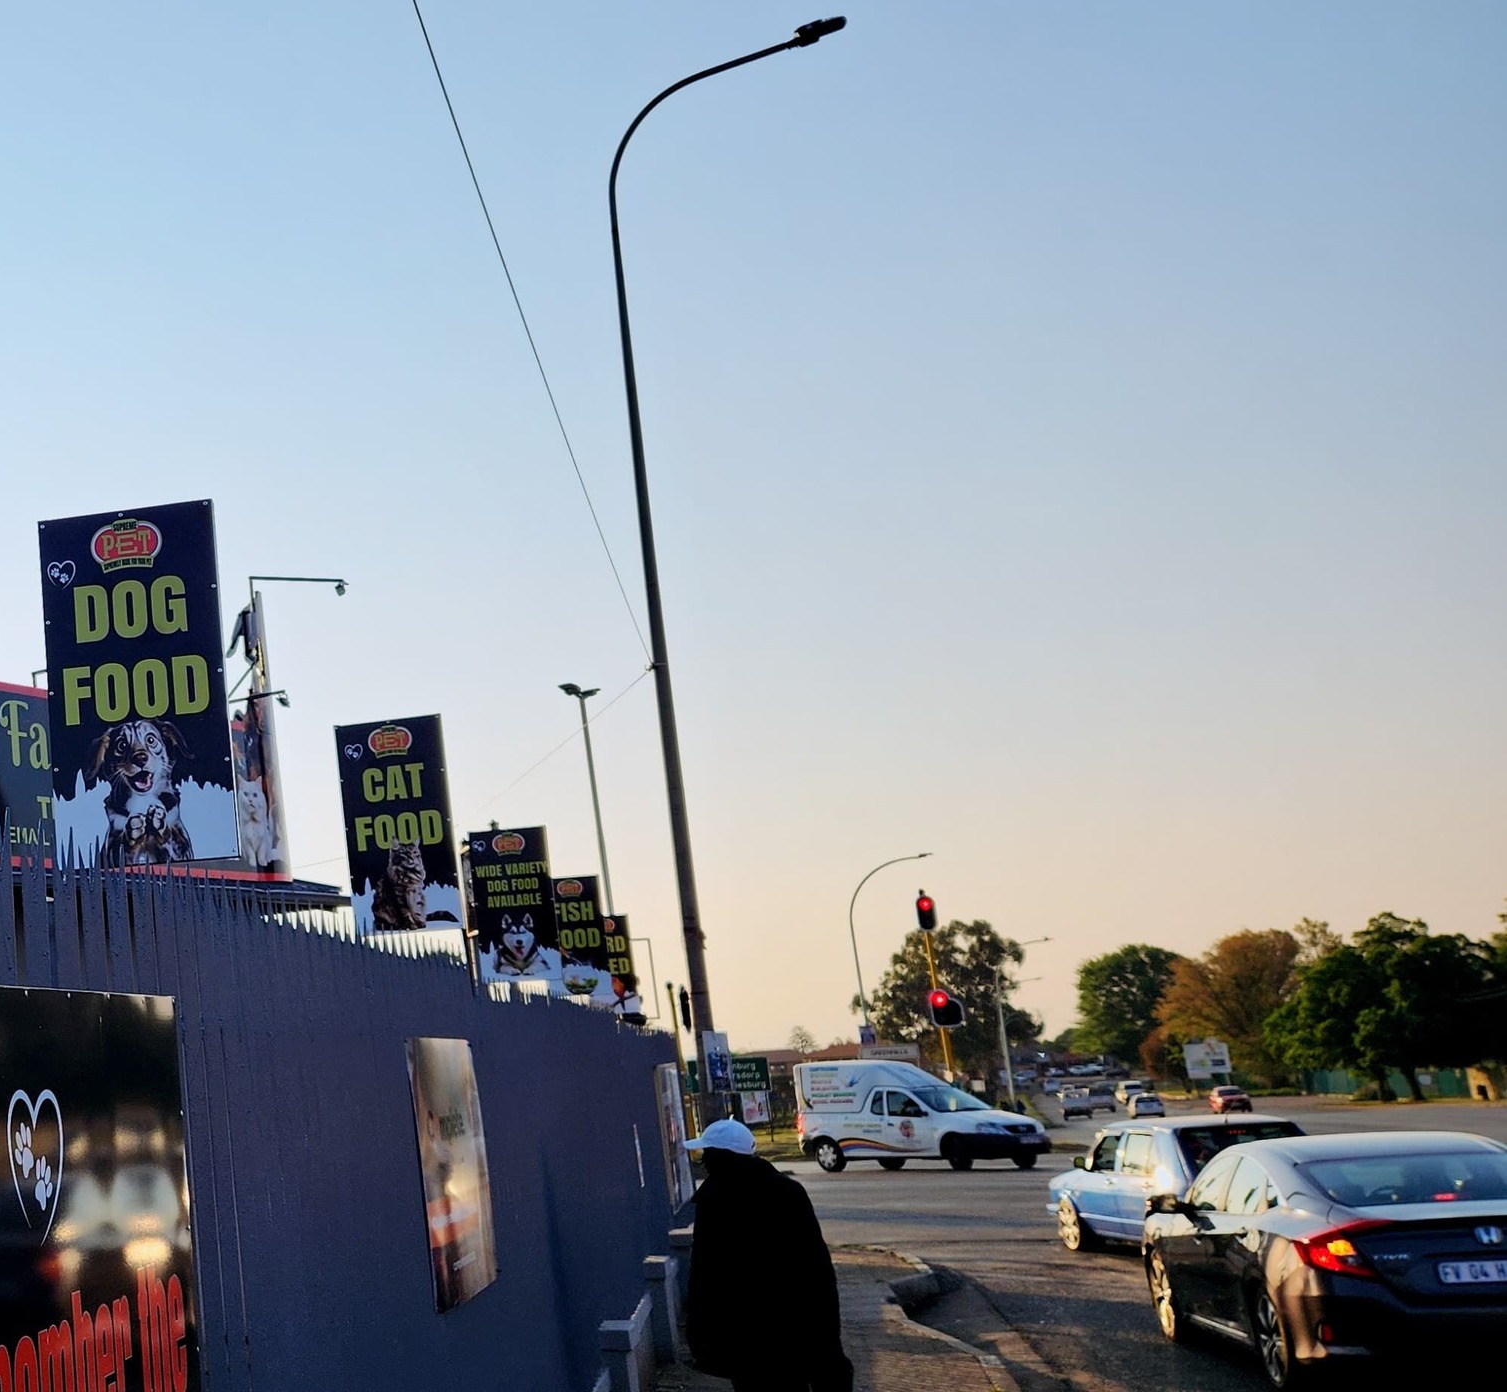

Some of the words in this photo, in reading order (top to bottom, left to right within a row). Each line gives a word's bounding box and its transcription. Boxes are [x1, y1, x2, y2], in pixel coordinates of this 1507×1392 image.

[101, 529, 151, 560] PET
[73, 575, 188, 644] DOG
[62, 654, 211, 726] FOOD
[374, 730, 407, 751] PET
[362, 762, 425, 803] CAT
[10, 826, 51, 847] EMAL
[354, 809, 444, 852] FOOD
[475, 864, 503, 878] WIDE
[505, 861, 548, 876] VARIETY
[487, 879, 509, 893] DOG
[511, 877, 539, 891] FOOD
[487, 892, 543, 909] AVAILABLE
[559, 927, 602, 949] OOD
[605, 935, 626, 953] RD
[609, 957, 630, 975] ED
[137, 1262, 188, 1392] the
